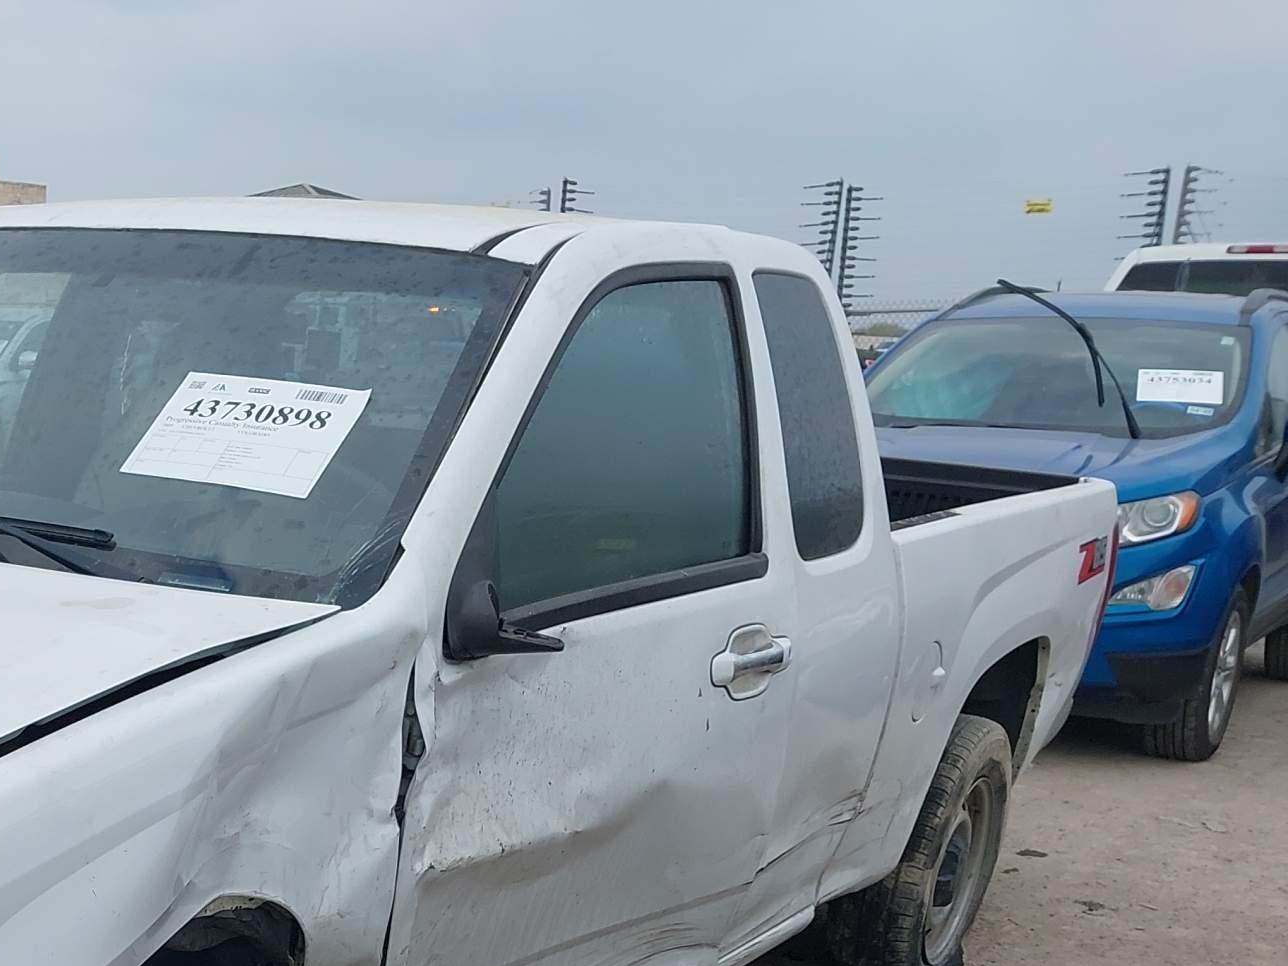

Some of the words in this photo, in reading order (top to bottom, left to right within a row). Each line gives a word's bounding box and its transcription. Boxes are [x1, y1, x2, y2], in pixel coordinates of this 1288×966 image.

[166, 416, 208, 425] Progressive
[208, 419, 240, 429] Casualty
[242, 422, 280, 432] Insurance
[183, 398, 332, 430] 43730898
